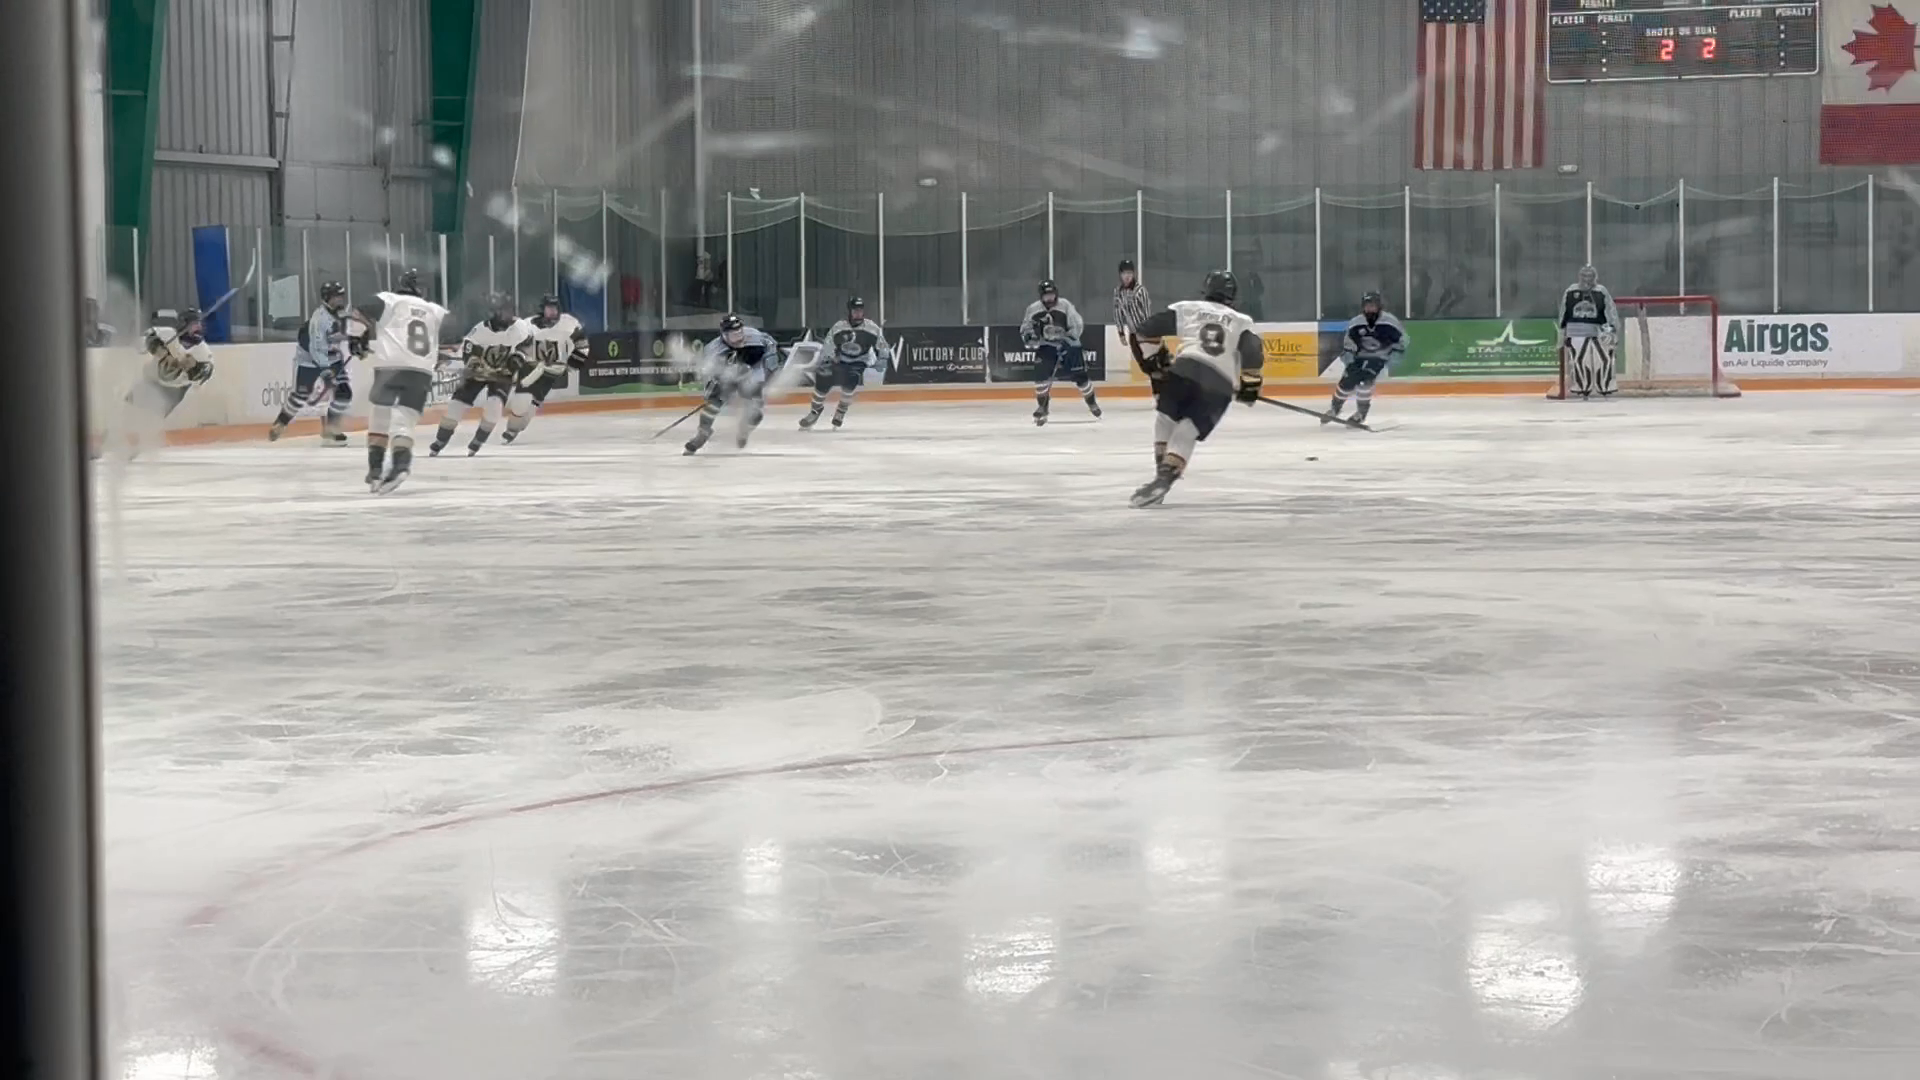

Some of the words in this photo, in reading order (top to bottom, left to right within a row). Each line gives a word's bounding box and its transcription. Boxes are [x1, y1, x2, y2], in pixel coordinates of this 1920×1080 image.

[1597, 13, 1633, 23] PENALTY
[1775, 7, 1813, 16] PENALTY
[1661, 39, 1675, 60] 2
[1702, 37, 1716, 58] 2
[407, 319, 431, 357] 8
[1723, 319, 1830, 355] Airgas
[1262, 338, 1303, 352] White
[912, 347, 954, 362] VICTORY
[958, 347, 984, 361] CLUB
[1722, 360, 1735, 368] an
[1736, 359, 1749, 367] Air
[1751, 359, 1785, 369] Liquide
[1786, 359, 1828, 368] company
